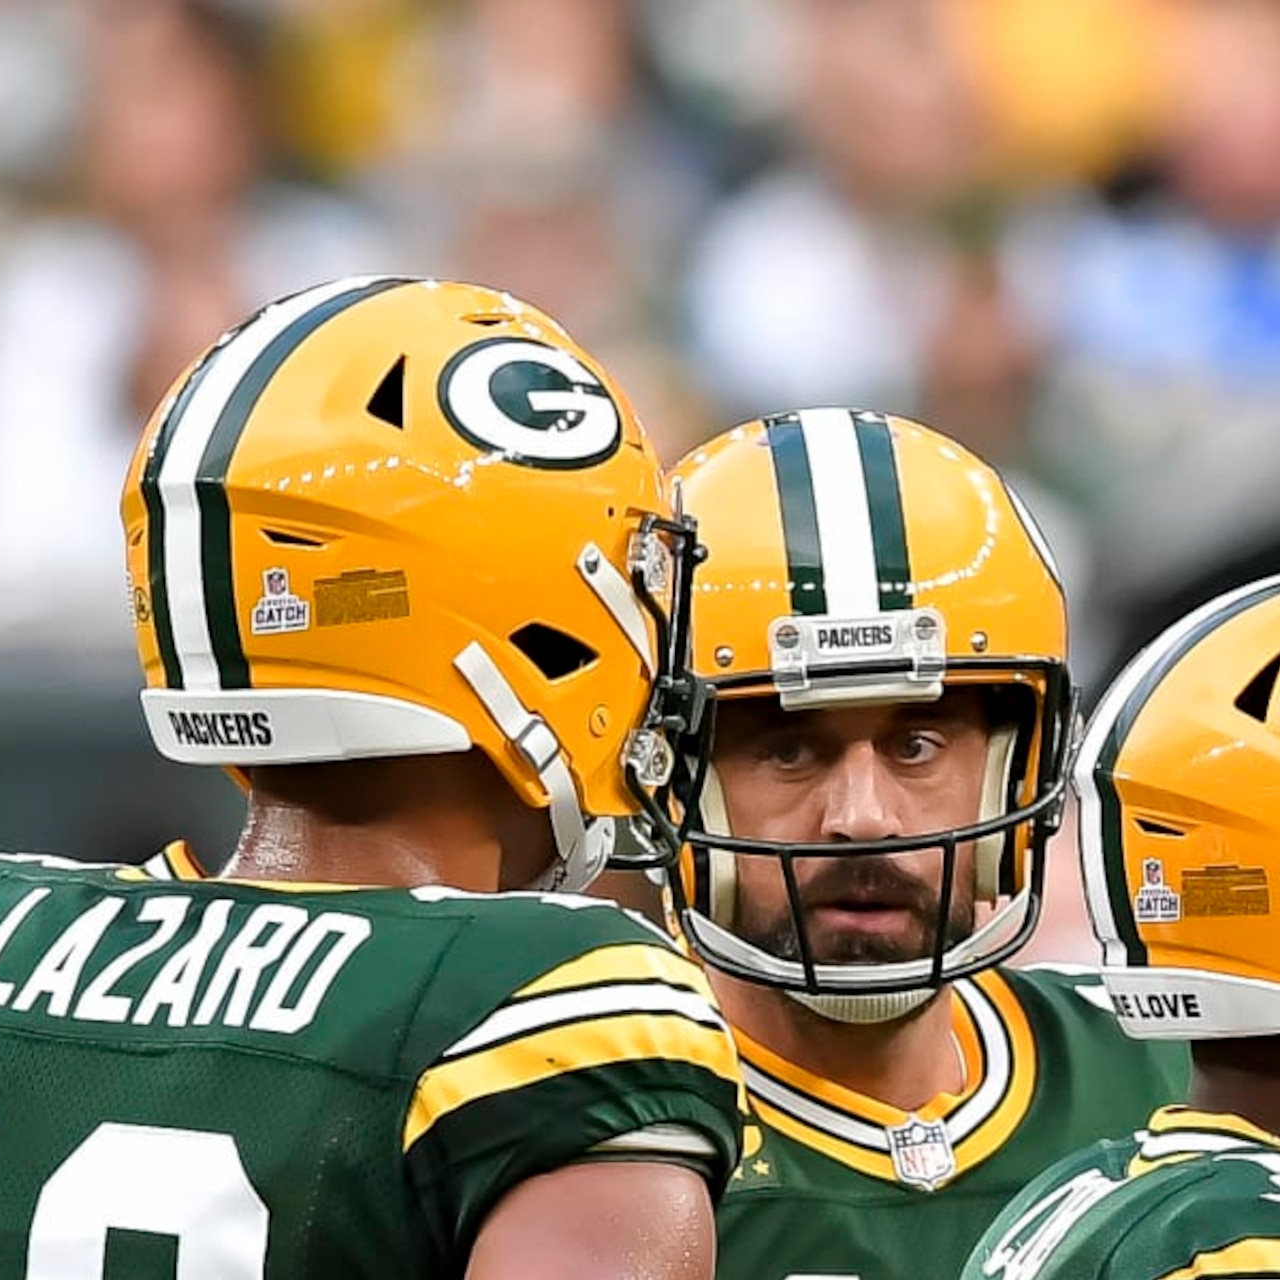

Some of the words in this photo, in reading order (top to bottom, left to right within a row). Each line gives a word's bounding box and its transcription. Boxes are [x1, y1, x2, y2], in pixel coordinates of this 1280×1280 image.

[255, 604, 306, 624] CATCH
[817, 624, 893, 649] PACKERS
[168, 711, 273, 747] PACKERS
[1134, 993, 1201, 1019] LOVE
